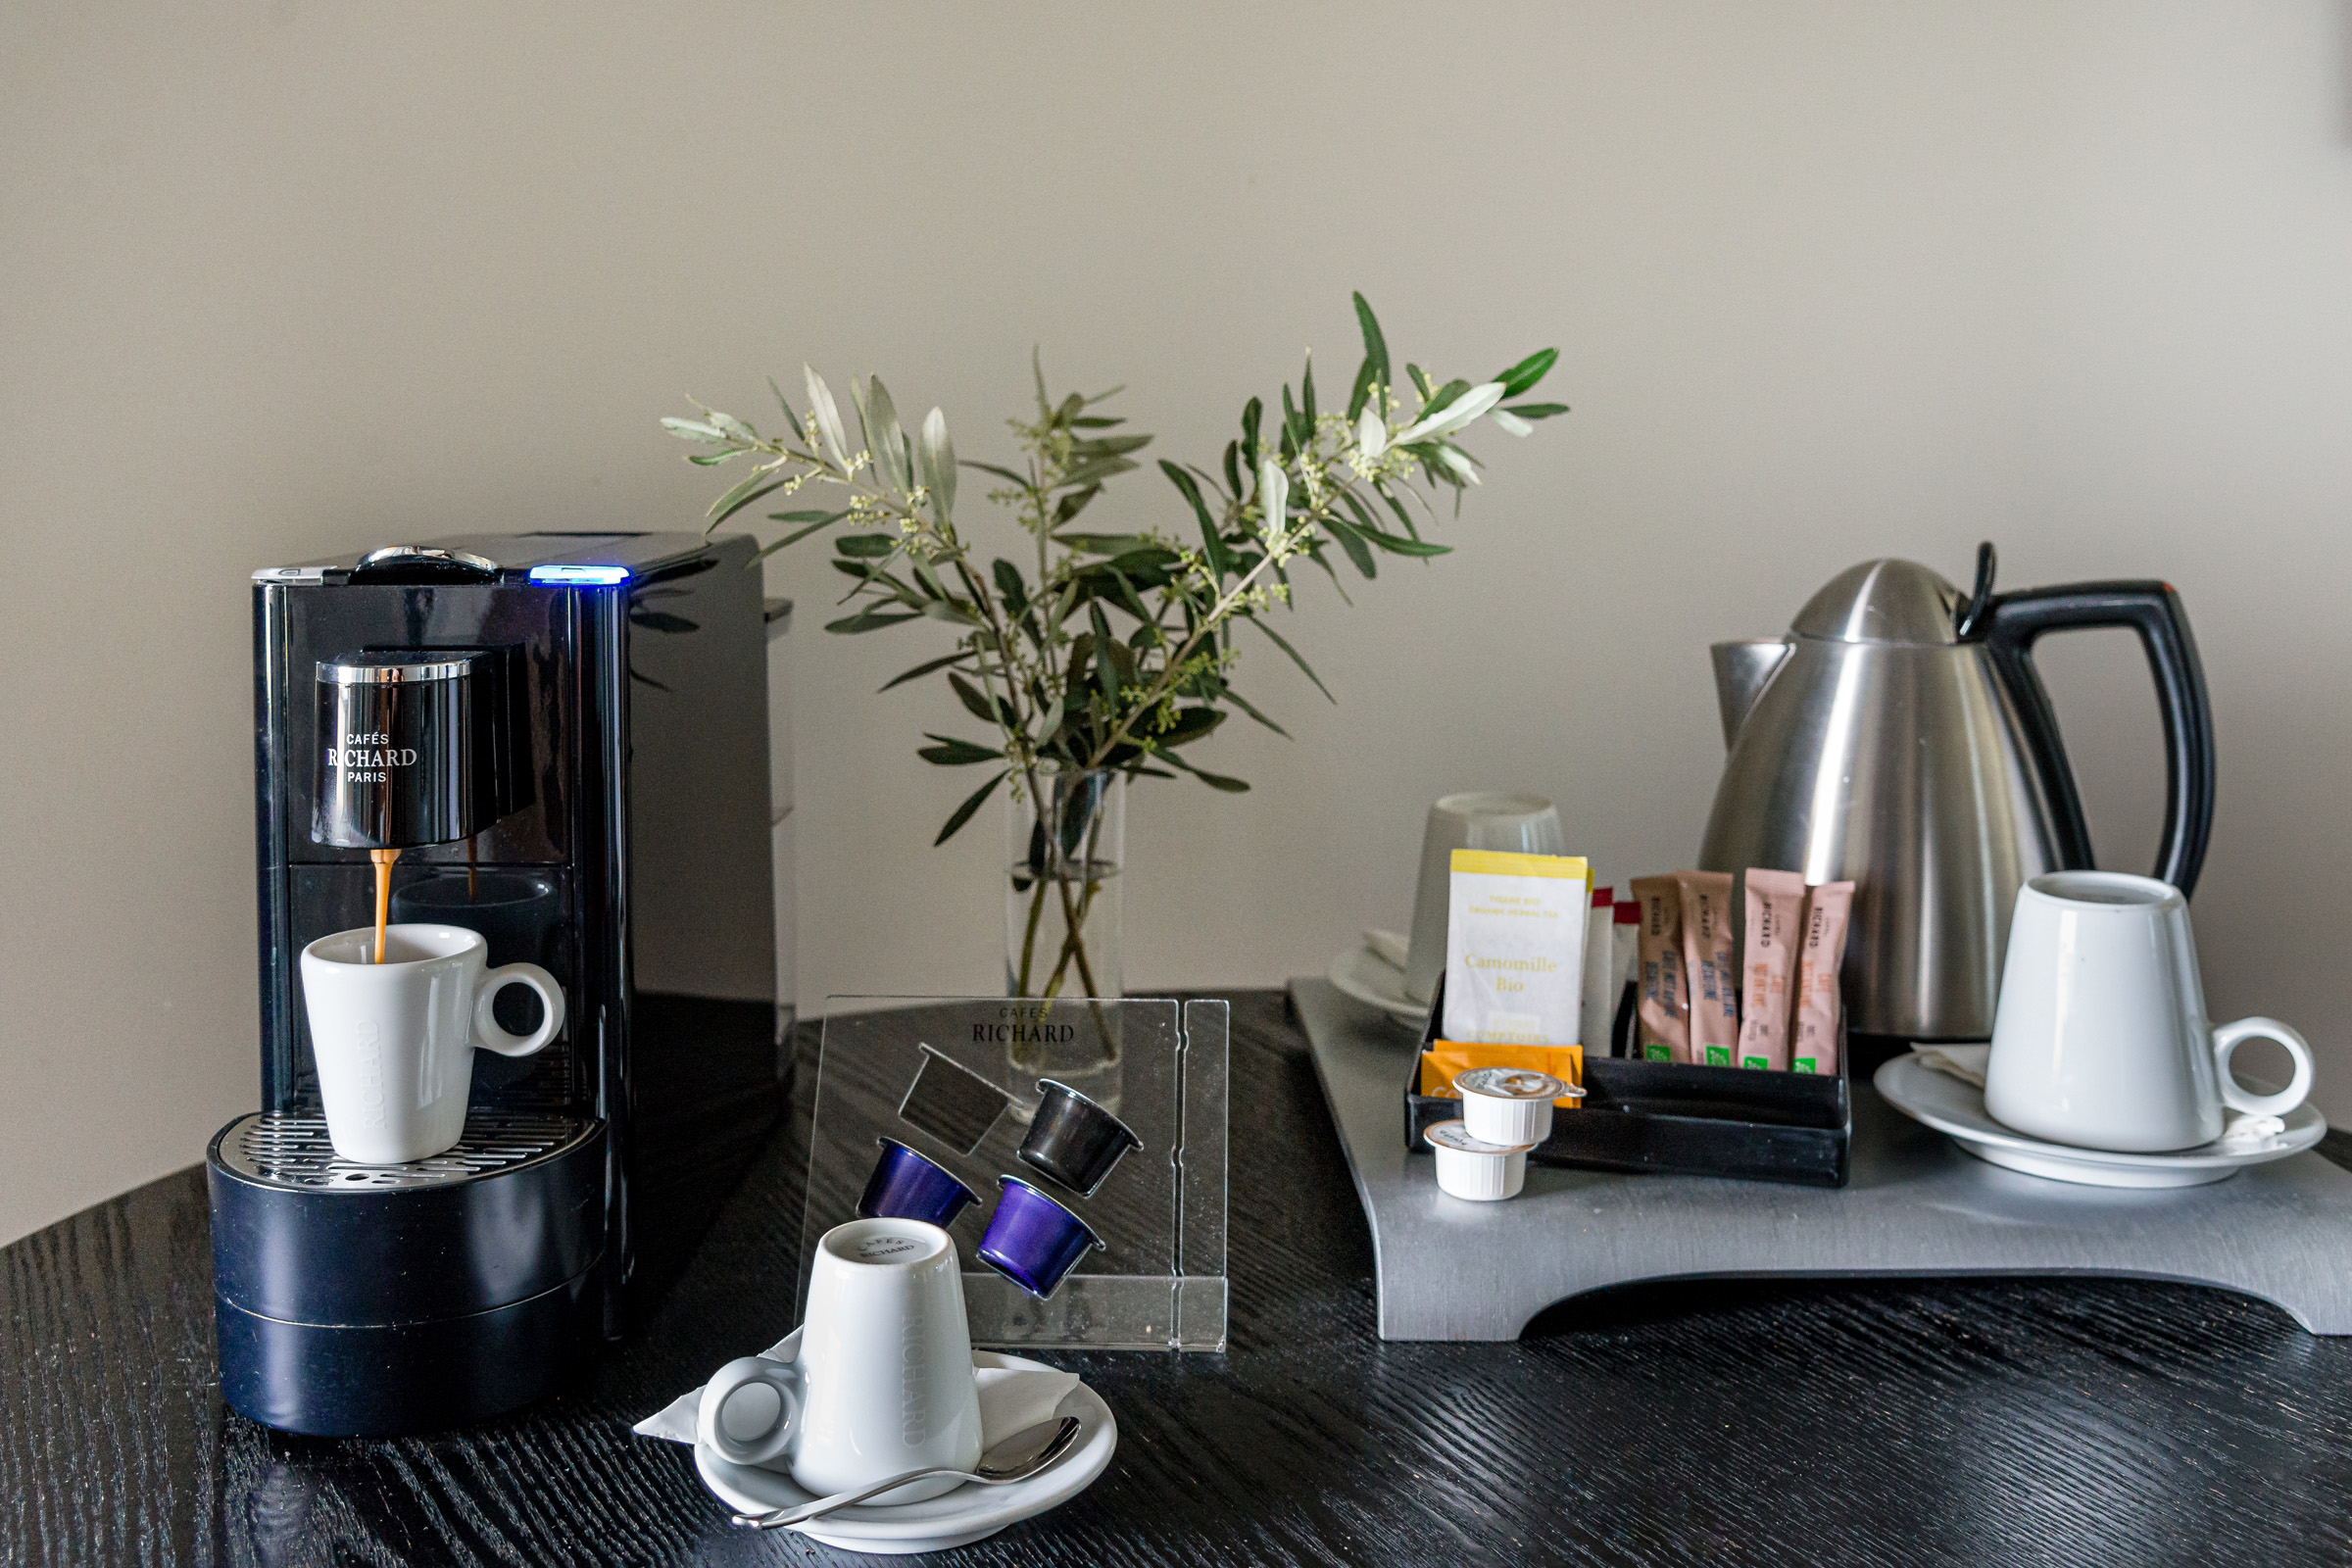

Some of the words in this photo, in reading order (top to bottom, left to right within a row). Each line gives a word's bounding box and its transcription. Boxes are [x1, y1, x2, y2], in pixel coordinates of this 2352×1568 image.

[346, 731, 389, 745] CAFÉS
[327, 748, 417, 766] RCHARD
[347, 771, 387, 783] PARIS
[1464, 954, 1557, 973] Camomille
[1495, 977, 1524, 993] Bio
[973, 1023, 1074, 1043] RICHARD
[902, 1311, 926, 1447] RICHARD
